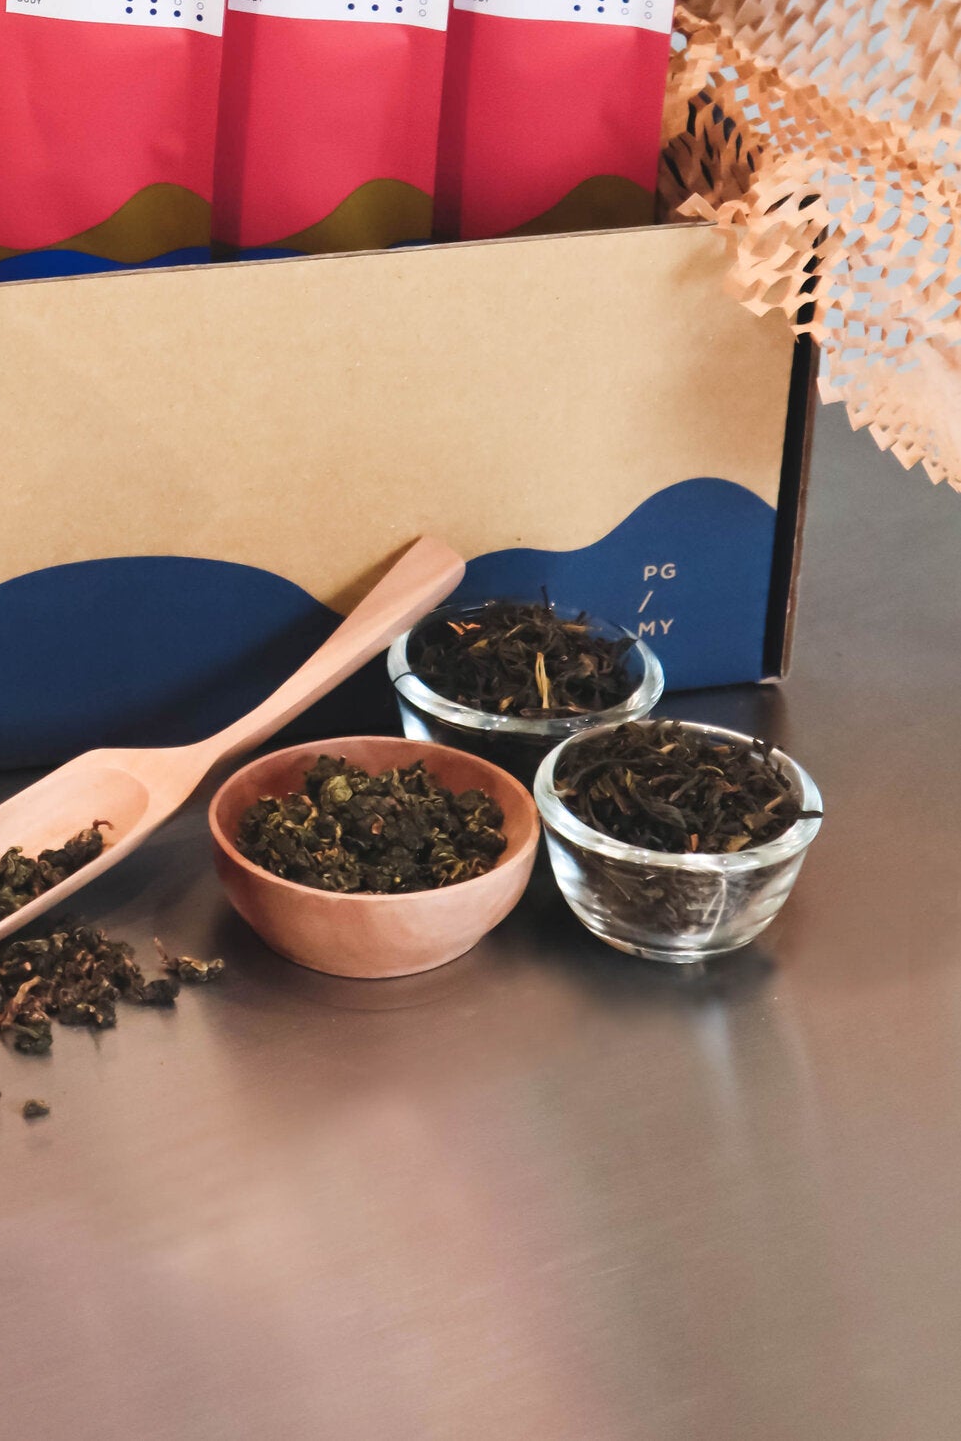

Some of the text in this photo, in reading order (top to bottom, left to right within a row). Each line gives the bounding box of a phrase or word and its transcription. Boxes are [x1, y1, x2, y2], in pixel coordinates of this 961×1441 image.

[643, 563, 677, 581] PG
[638, 591, 653, 613] /
[638, 619, 674, 637] MY
